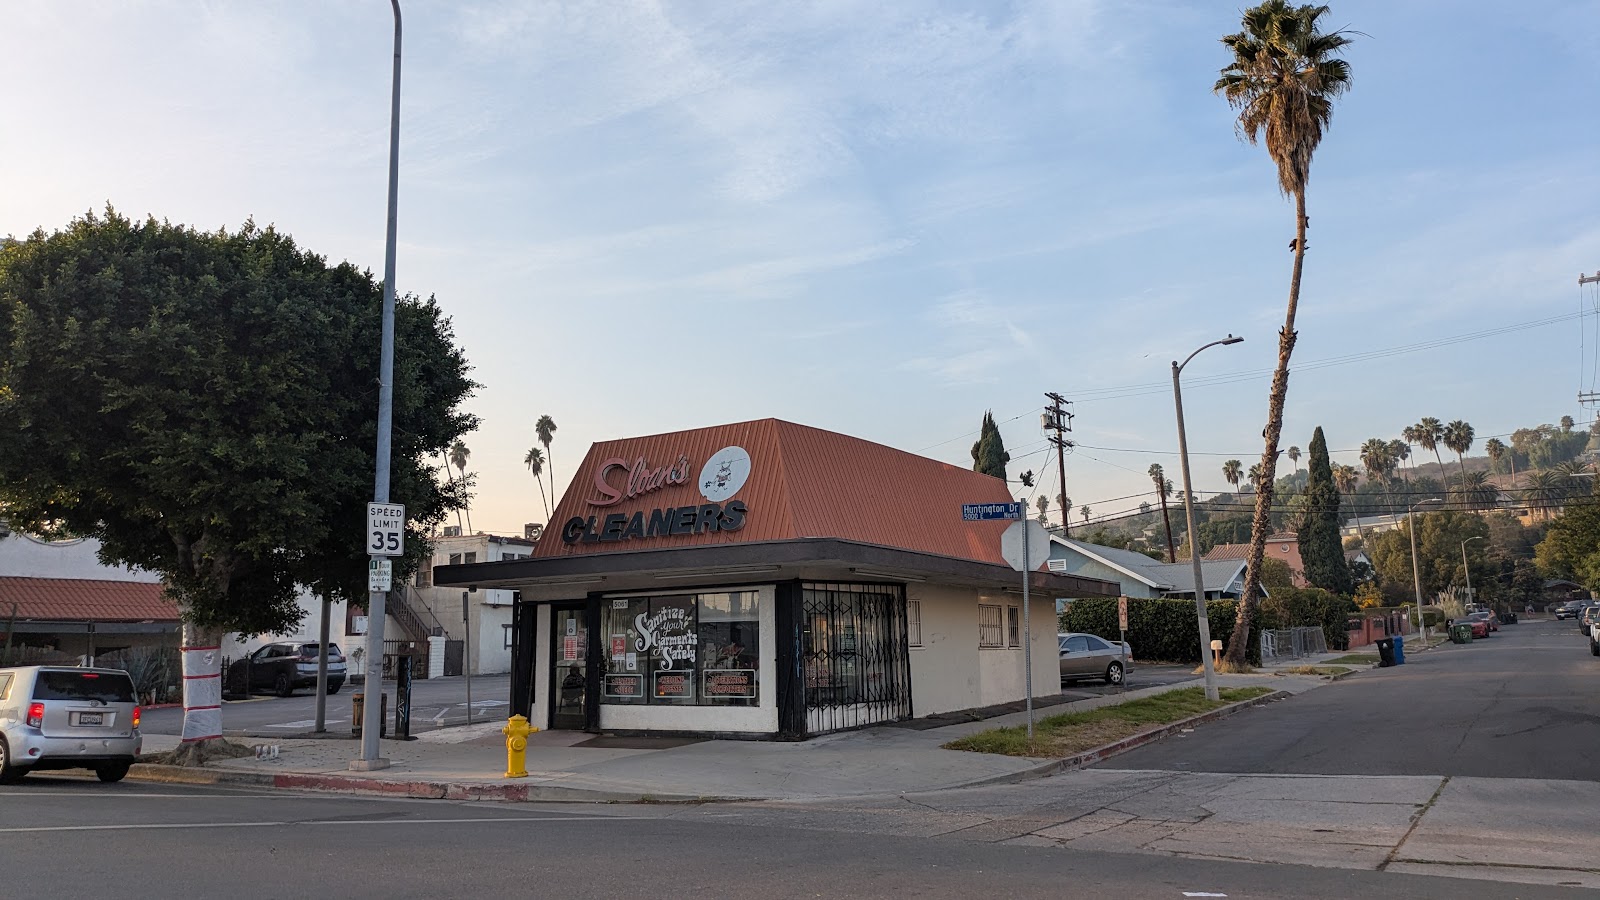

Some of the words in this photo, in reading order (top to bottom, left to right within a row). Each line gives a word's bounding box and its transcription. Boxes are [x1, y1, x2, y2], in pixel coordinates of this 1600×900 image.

[585, 454, 692, 507] Sloan's
[370, 507, 402, 517] SPEED
[963, 504, 1005, 515] Huntington
[1009, 503, 1019, 512] Dr
[373, 519, 399, 528] LIMIT
[562, 500, 748, 545] CLEANERS
[371, 531, 400, 551] 35
[635, 606, 685, 652] Sanitize
[660, 620, 684, 636] your
[651, 629, 698, 656] Garments
[660, 645, 696, 671] Safely
